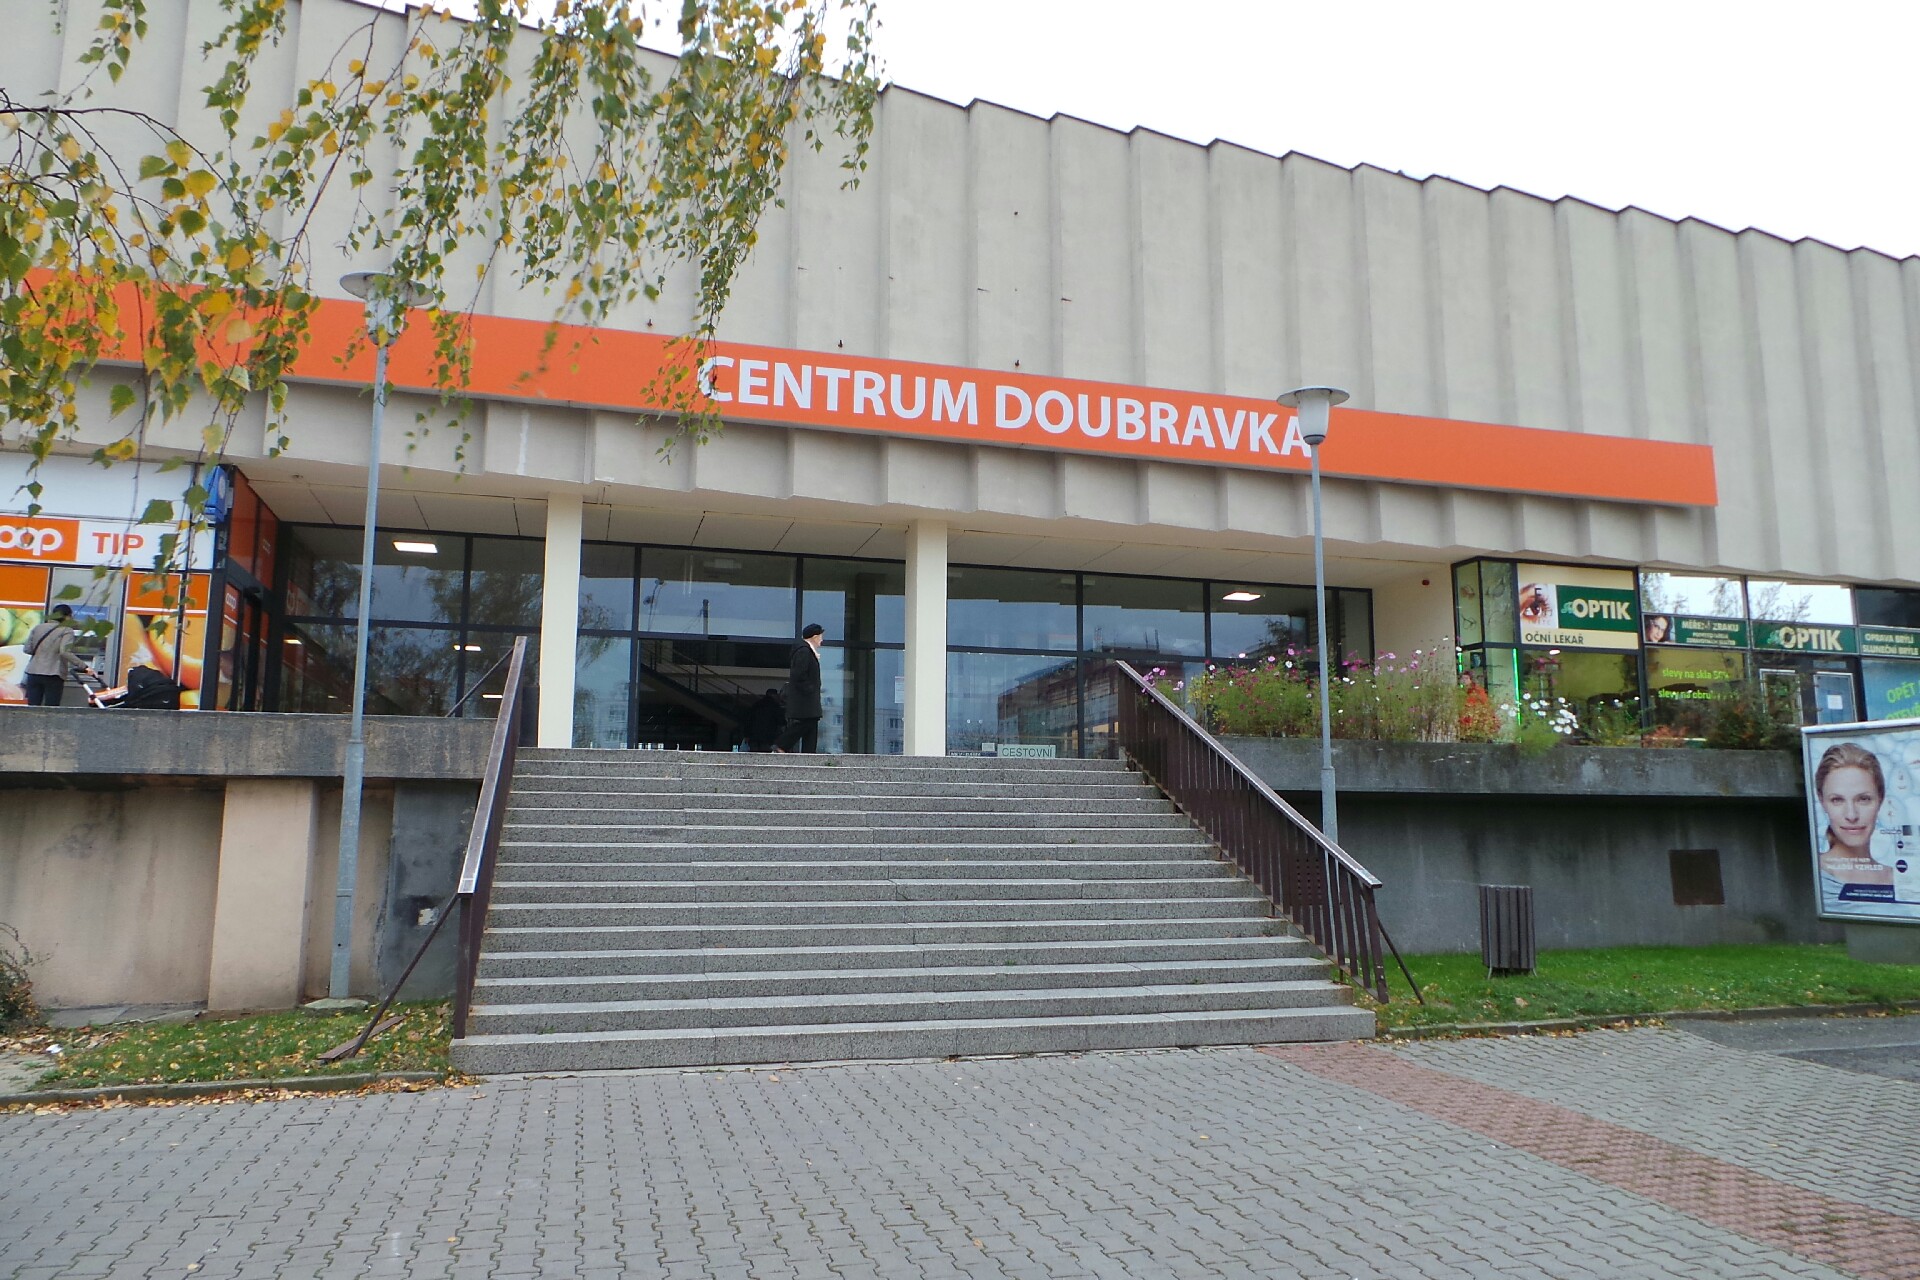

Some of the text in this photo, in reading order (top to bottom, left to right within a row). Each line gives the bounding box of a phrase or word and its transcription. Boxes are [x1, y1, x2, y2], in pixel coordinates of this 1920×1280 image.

[698, 356, 1312, 457] CENTRUM DOUBRAVKA
[0, 525, 145, 556] oop TIP
[1572, 598, 1632, 620] OPTIK
[1525, 631, 1551, 643] OČNÍ
[1779, 626, 1843, 651] OPTIK
[1662, 668, 1683, 679] slevy
[1696, 669, 1712, 679] skla
[1658, 688, 1680, 699] slevy
[1887, 681, 1915, 704] OPĚT
[1002, 747, 1052, 758] CESTOVNÍ
